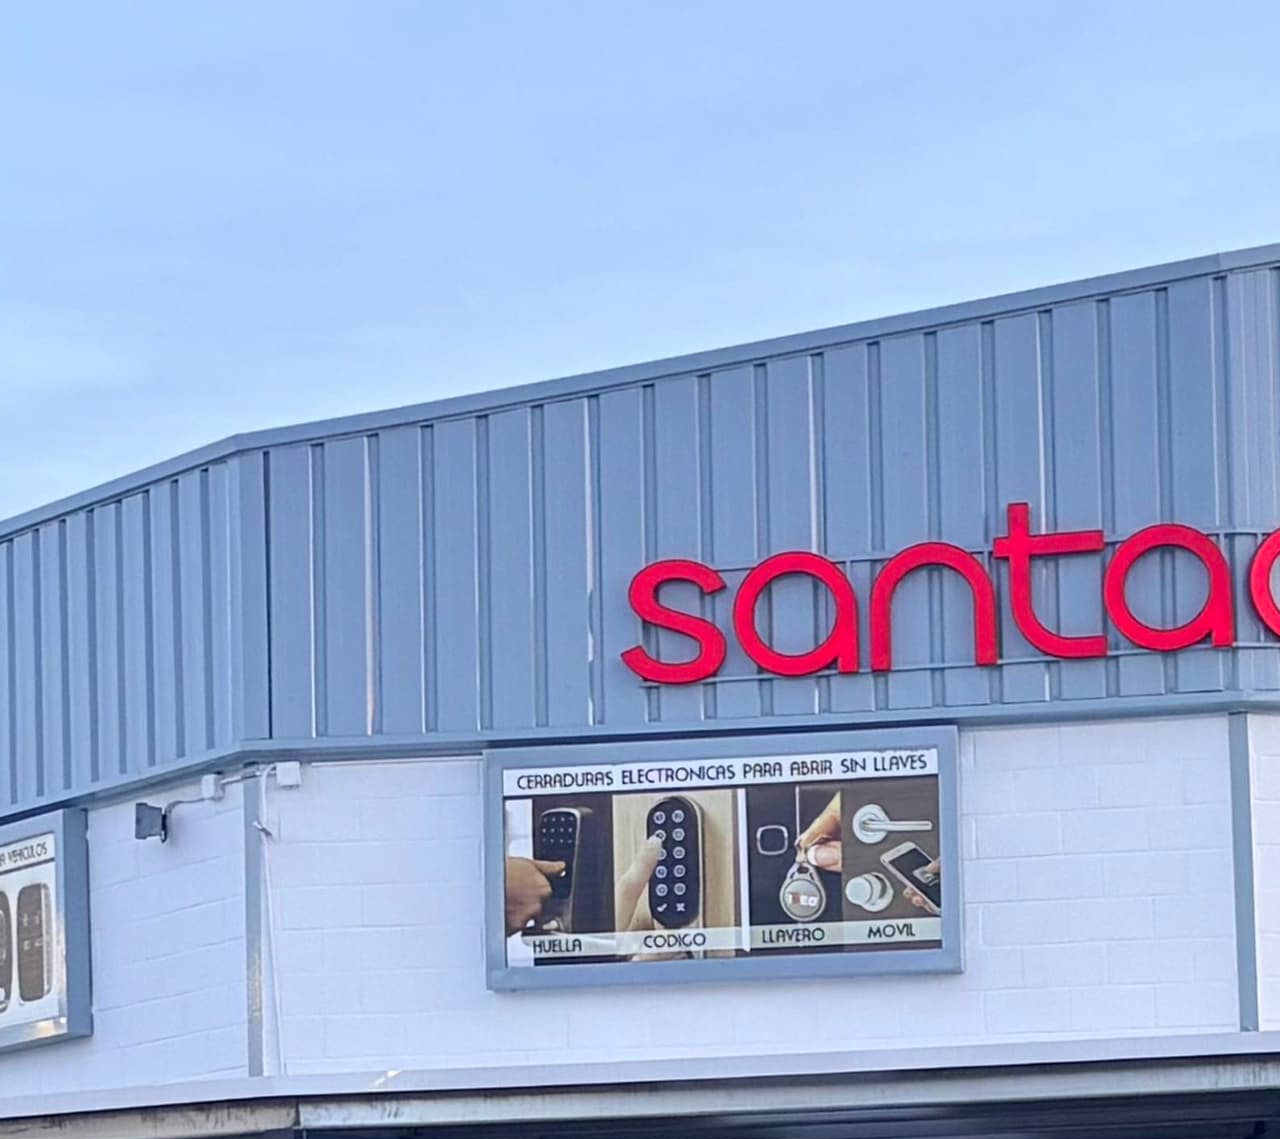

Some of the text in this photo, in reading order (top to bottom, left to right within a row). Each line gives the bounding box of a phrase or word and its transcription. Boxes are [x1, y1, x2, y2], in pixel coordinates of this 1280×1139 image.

[517, 754, 928, 790] CERRADURAS ELECTRONICAS PARA ABRIR SIN LLAVES
[762, 927, 825, 944] LLAVERO
[867, 923, 916, 939] MOVIL
[533, 938, 582, 954] HUELLA
[643, 933, 706, 948] CODIGO
